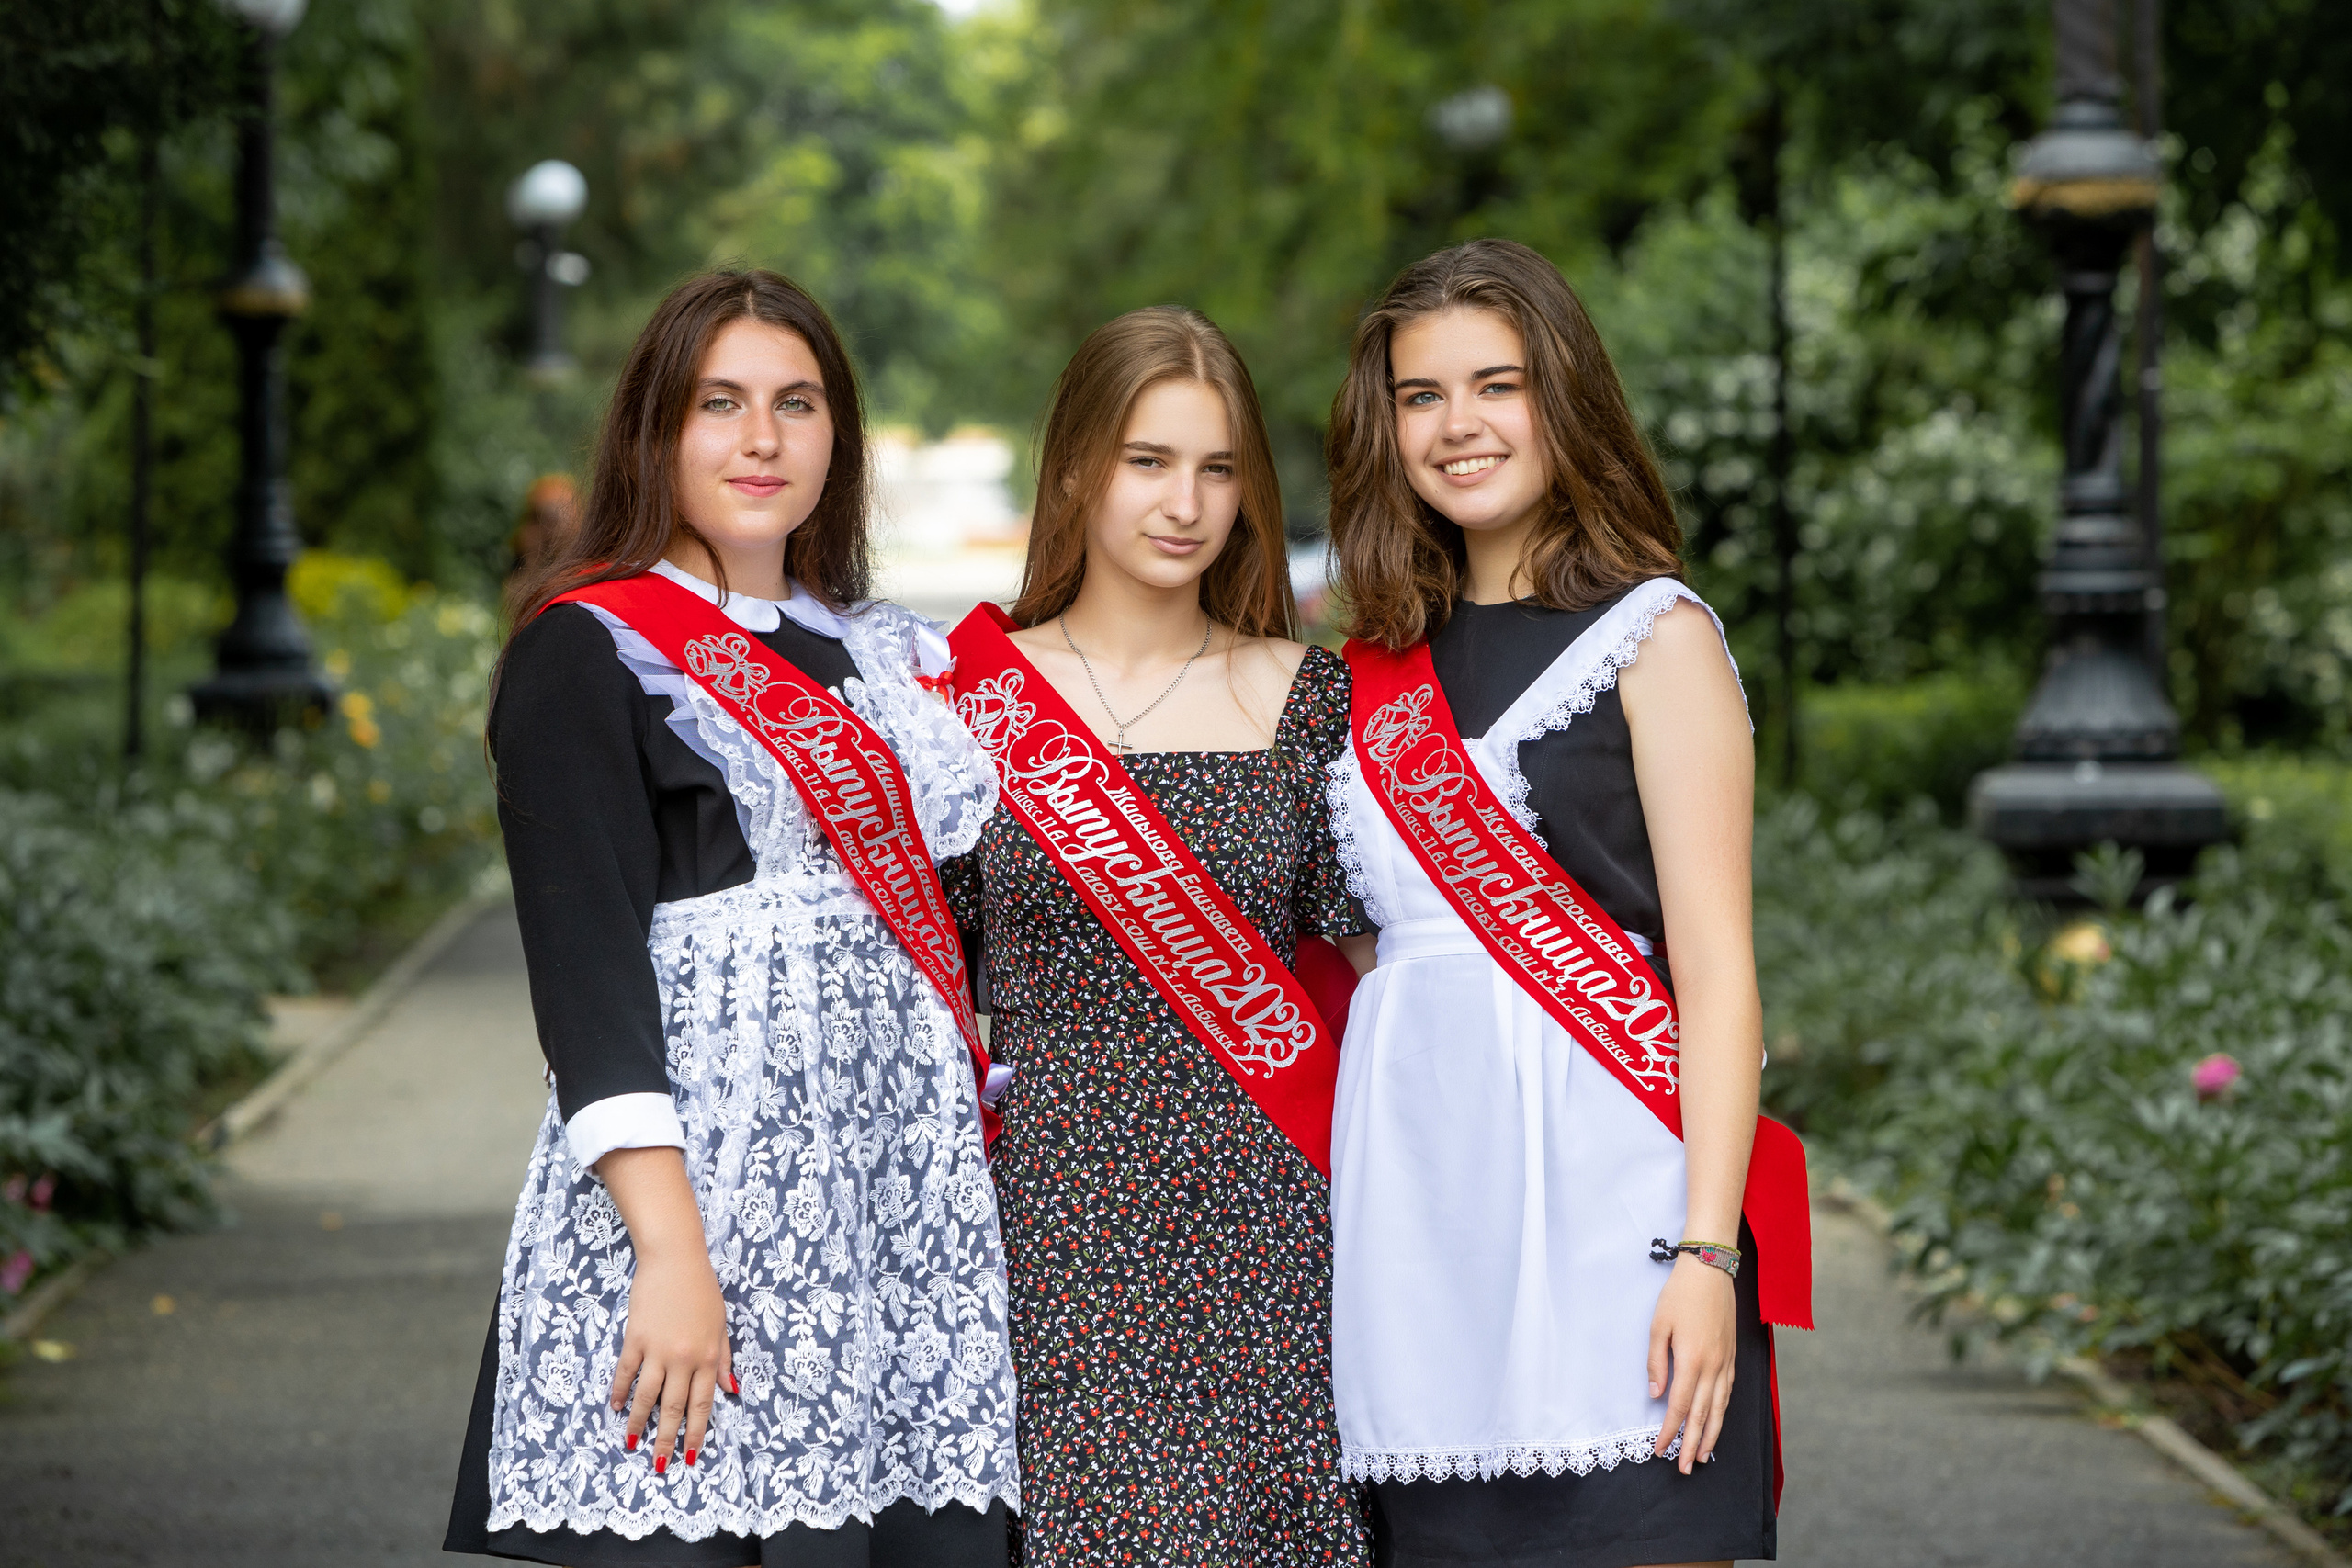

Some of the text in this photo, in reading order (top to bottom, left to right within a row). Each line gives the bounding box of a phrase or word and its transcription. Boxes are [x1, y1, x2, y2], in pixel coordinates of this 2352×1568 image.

[772, 736, 808, 772] класс
[804, 772, 822, 786] 11
[838, 830, 873, 875] МОБУ
[869, 880, 897, 916] СОШ
[862, 750, 947, 925] Мишина Алена
[1011, 788, 1043, 818] класс
[1039, 816, 1057, 831] 11
[1078, 866, 1126, 913] МОБУ
[1120, 917, 1157, 953] СОШ
[1162, 969, 1180, 980] 3
[1105, 785, 1253, 953] Жильцова Елизавета
[1396, 802, 1426, 837] класс
[1423, 836, 1439, 851] 11
[1456, 886, 1502, 931] МОБУ
[1498, 935, 1539, 967] СОШ
[1548, 983, 1566, 994] 3
[1476, 805, 1634, 964] Жукова Ярослава
